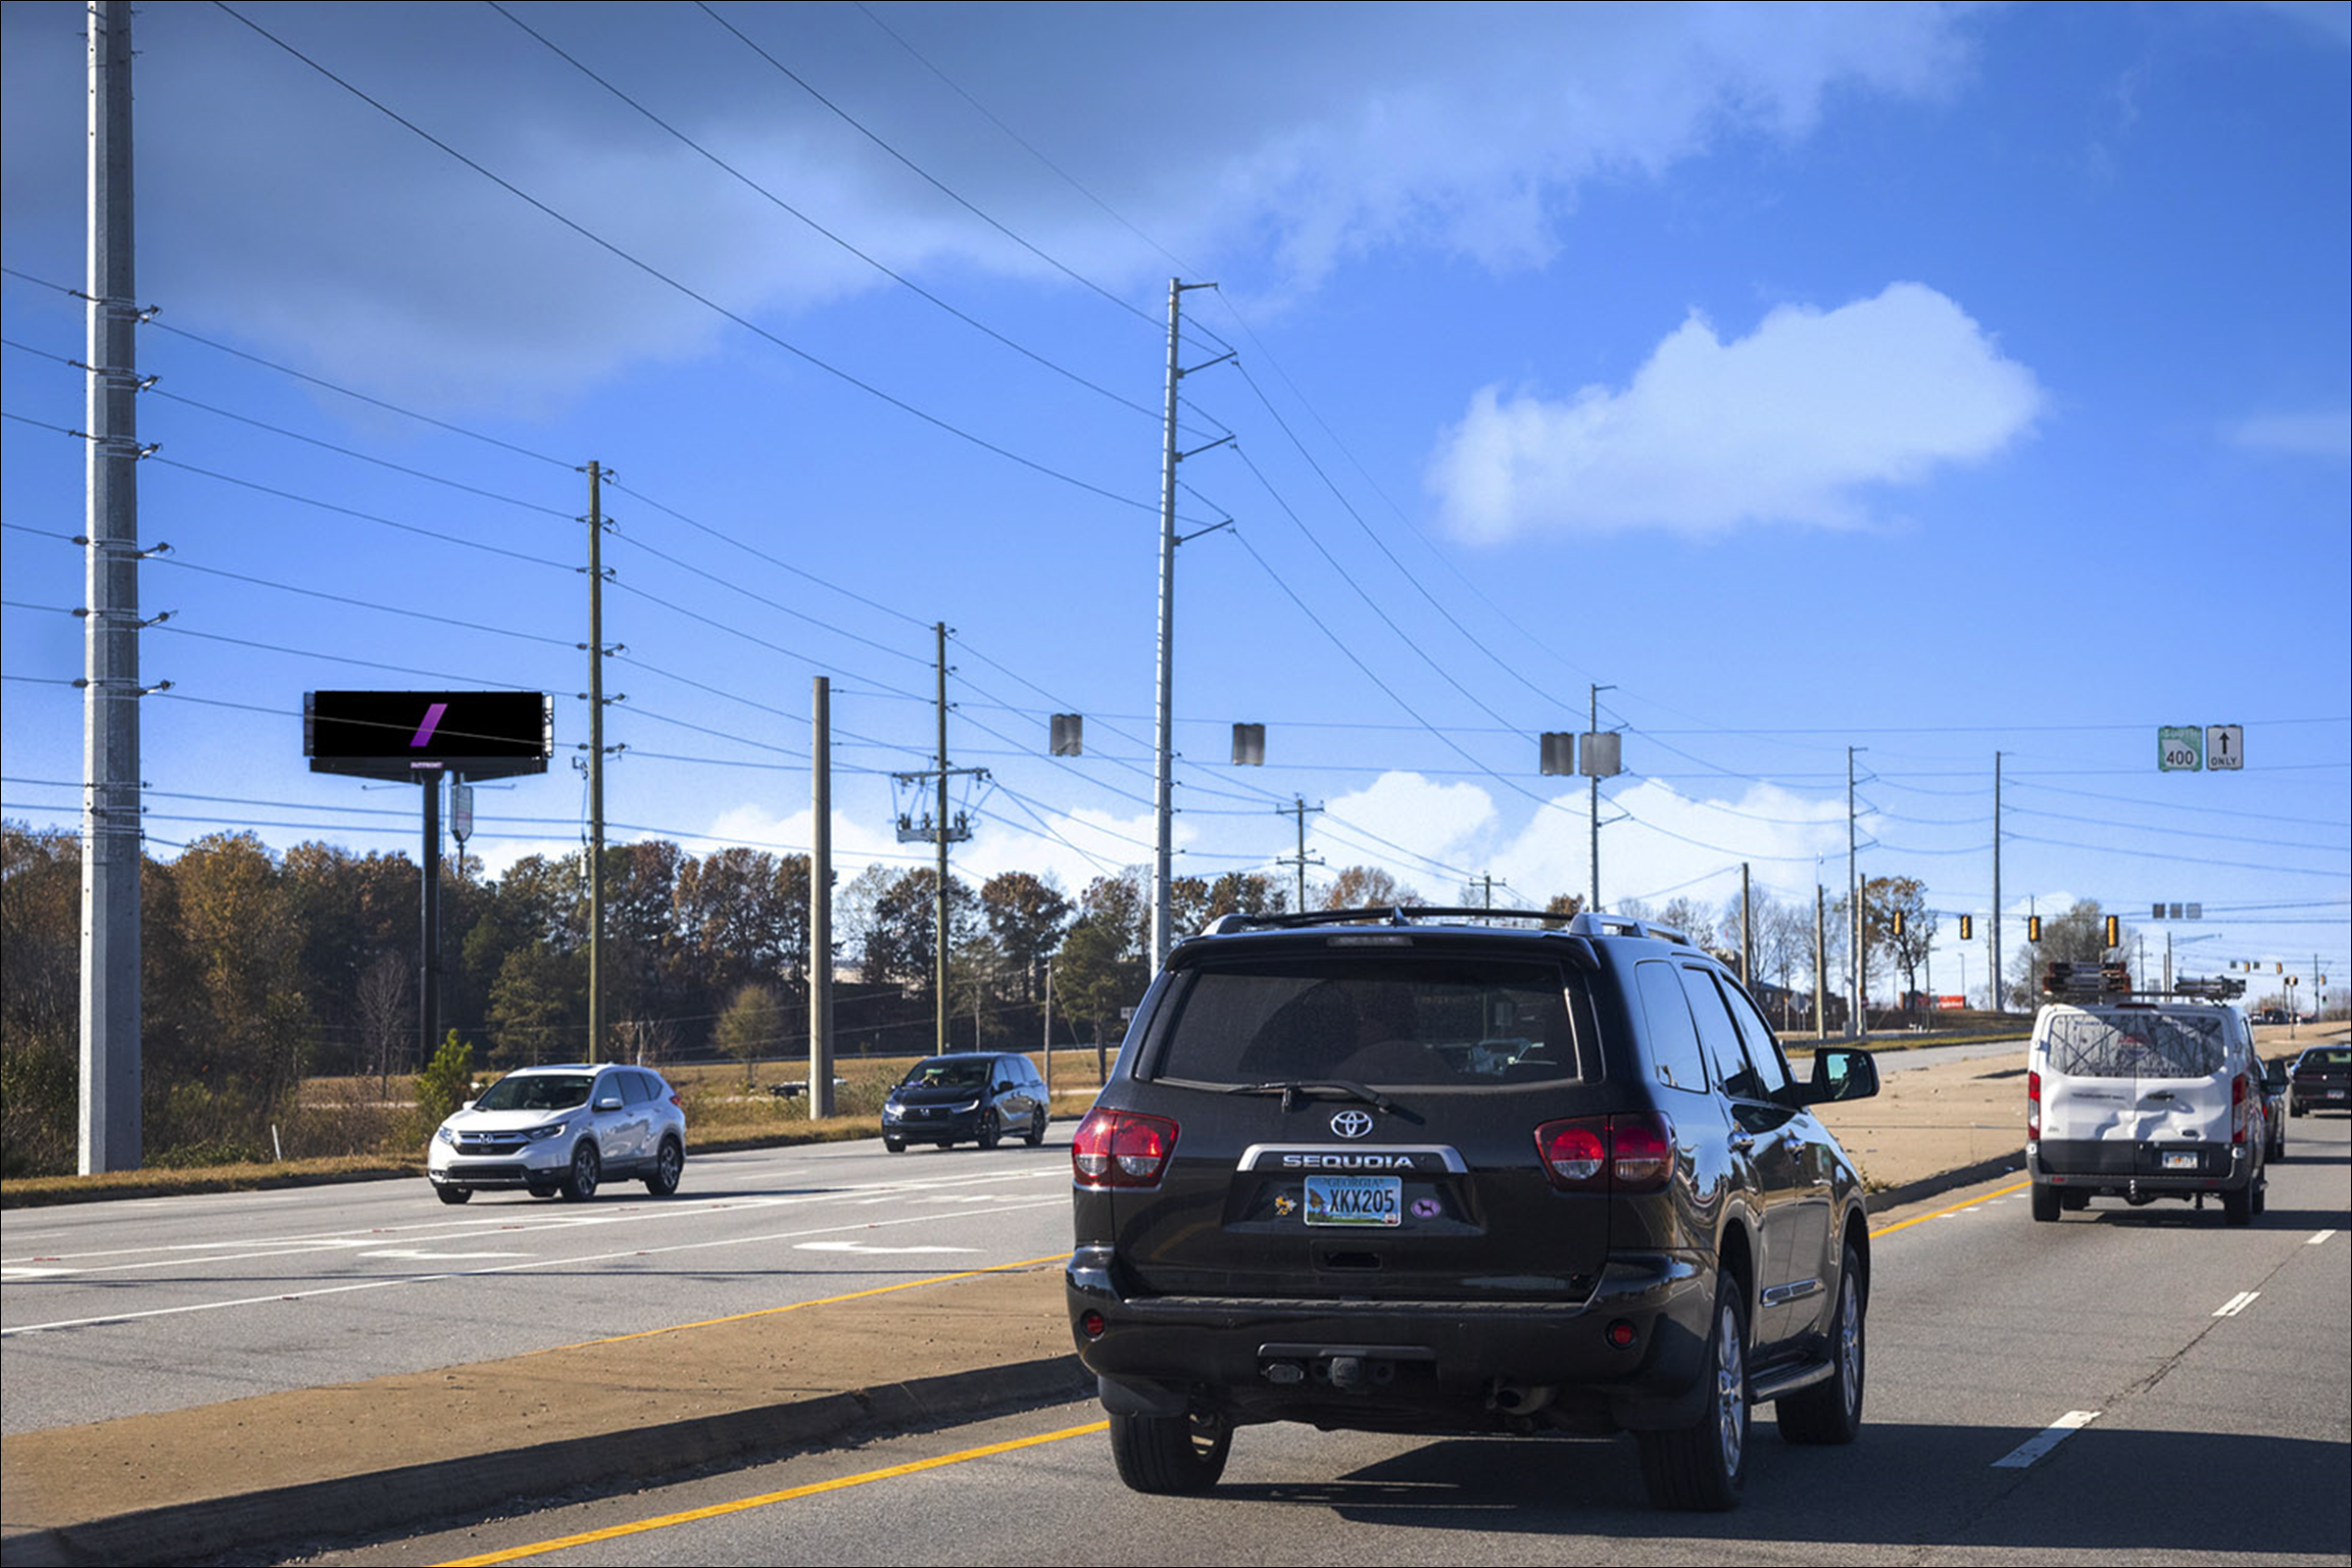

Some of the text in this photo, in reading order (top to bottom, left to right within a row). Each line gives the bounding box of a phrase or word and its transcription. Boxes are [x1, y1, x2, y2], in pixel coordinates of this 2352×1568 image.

[2166, 751, 2194, 765] 400
[2211, 757, 2237, 765] ONLY
[1283, 1154, 1415, 1169] SEQUOIA
[1327, 1178, 1380, 1187] GEORGIA
[1330, 1189, 1395, 1213] XKX205
